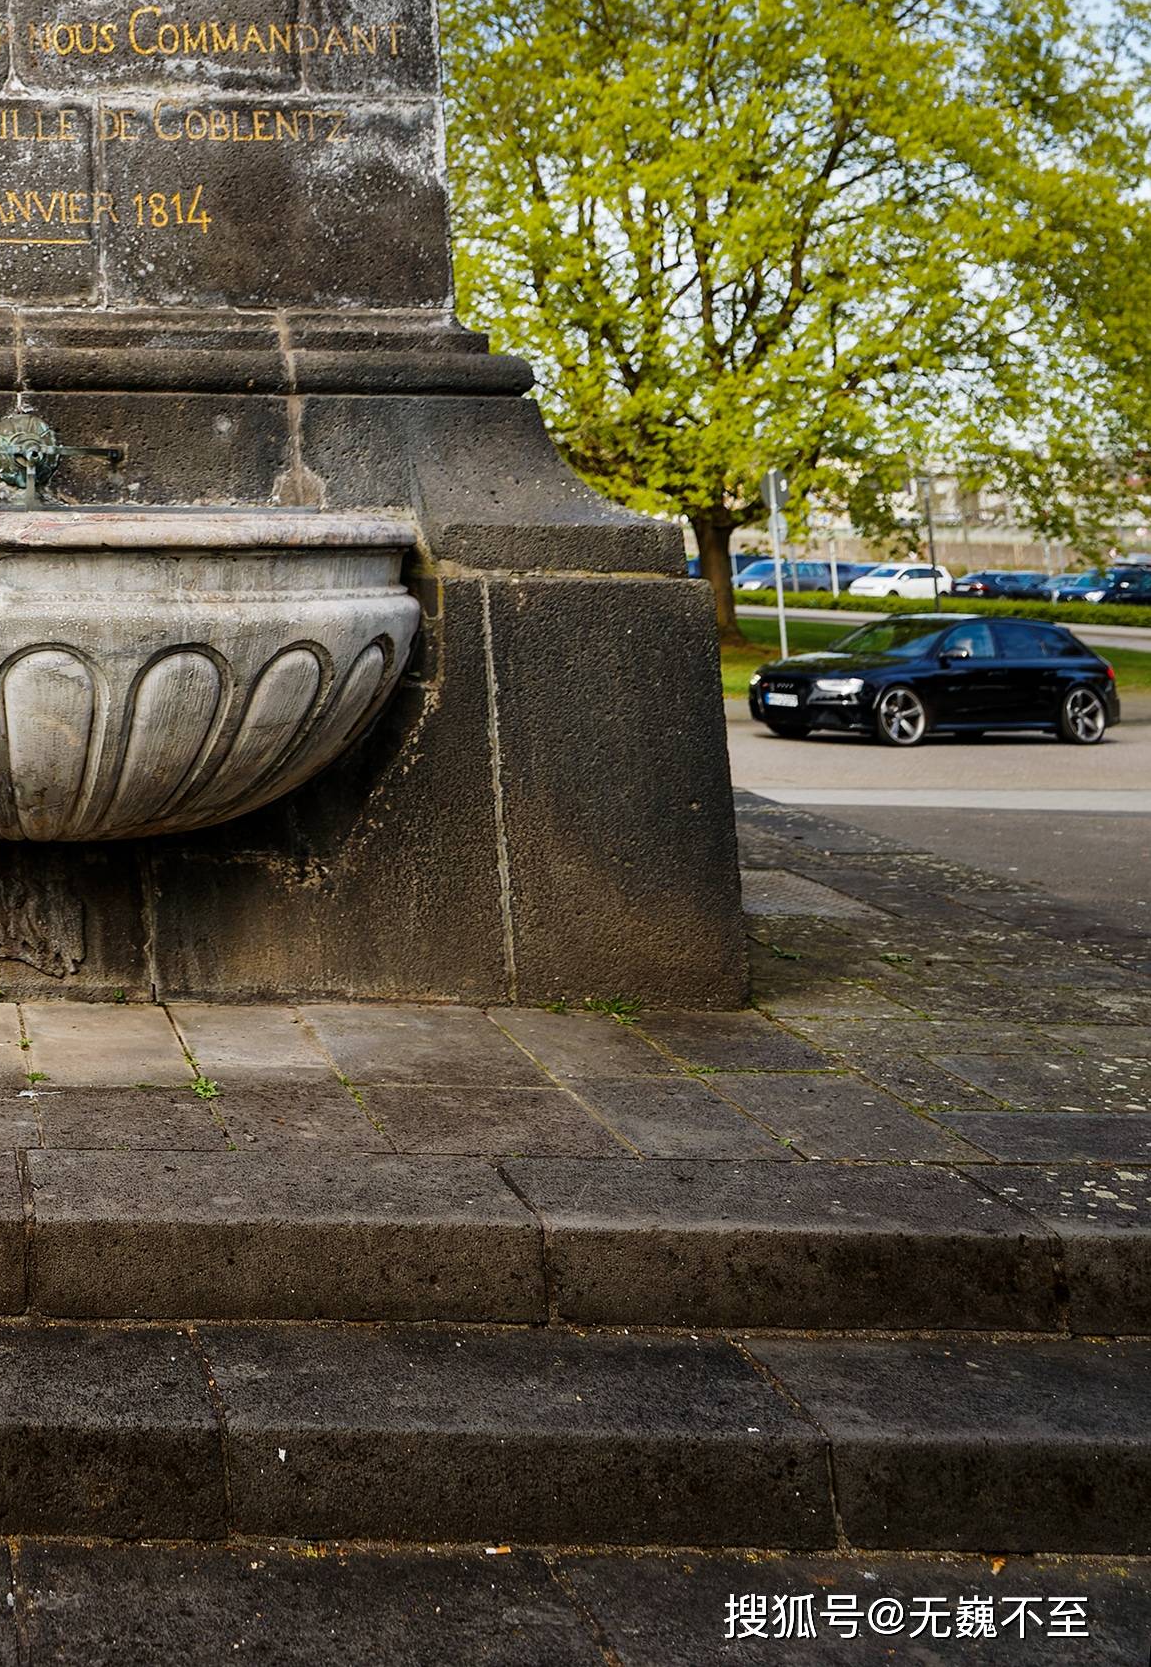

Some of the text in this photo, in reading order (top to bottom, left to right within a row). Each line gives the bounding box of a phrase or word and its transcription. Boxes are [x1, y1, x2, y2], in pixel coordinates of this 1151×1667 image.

[28, 21, 118, 55] NOUS
[129, 6, 406, 55] COMMANDANT
[99, 109, 141, 142] DE
[133, 184, 212, 234] 1814
